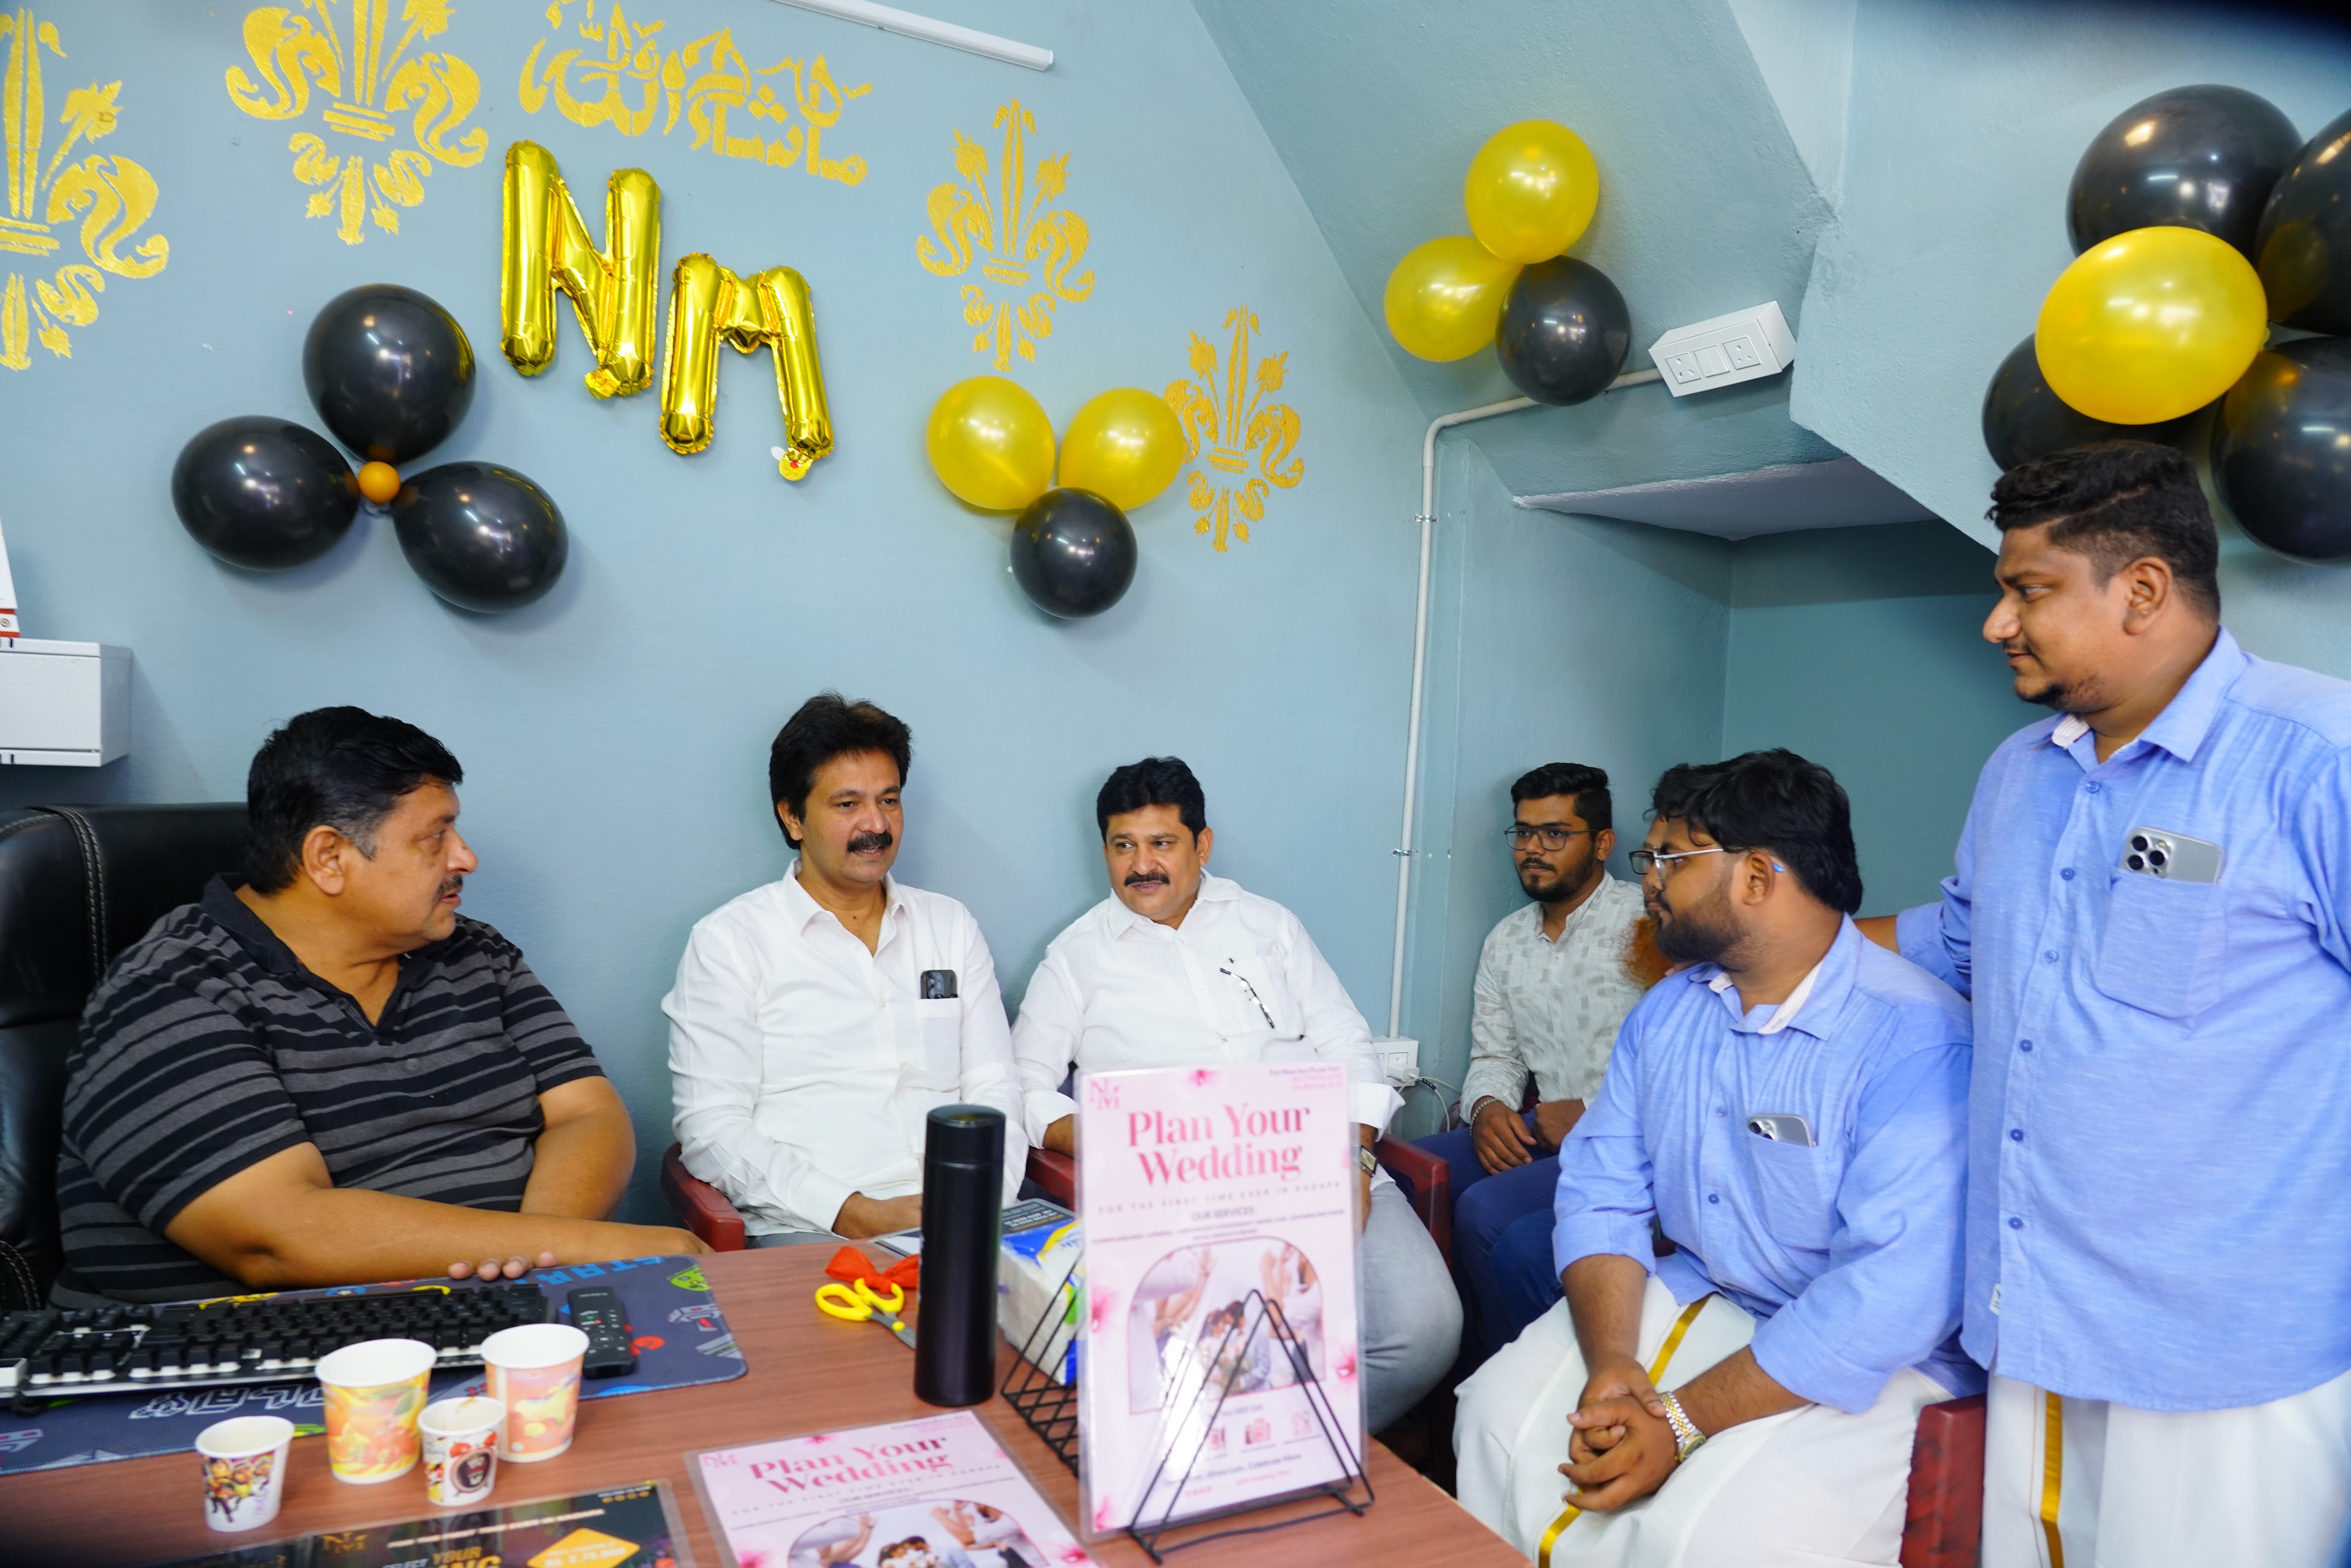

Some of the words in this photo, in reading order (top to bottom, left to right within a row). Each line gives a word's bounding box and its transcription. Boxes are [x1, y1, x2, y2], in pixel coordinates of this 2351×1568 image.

[1128, 1108, 1213, 1147] Plan
[1224, 1102, 1310, 1138] Your
[1138, 1142, 1303, 1186] Wedding
[749, 1454, 845, 1479] Plan
[850, 1434, 948, 1461] Your
[767, 1453, 953, 1495] Wedding
